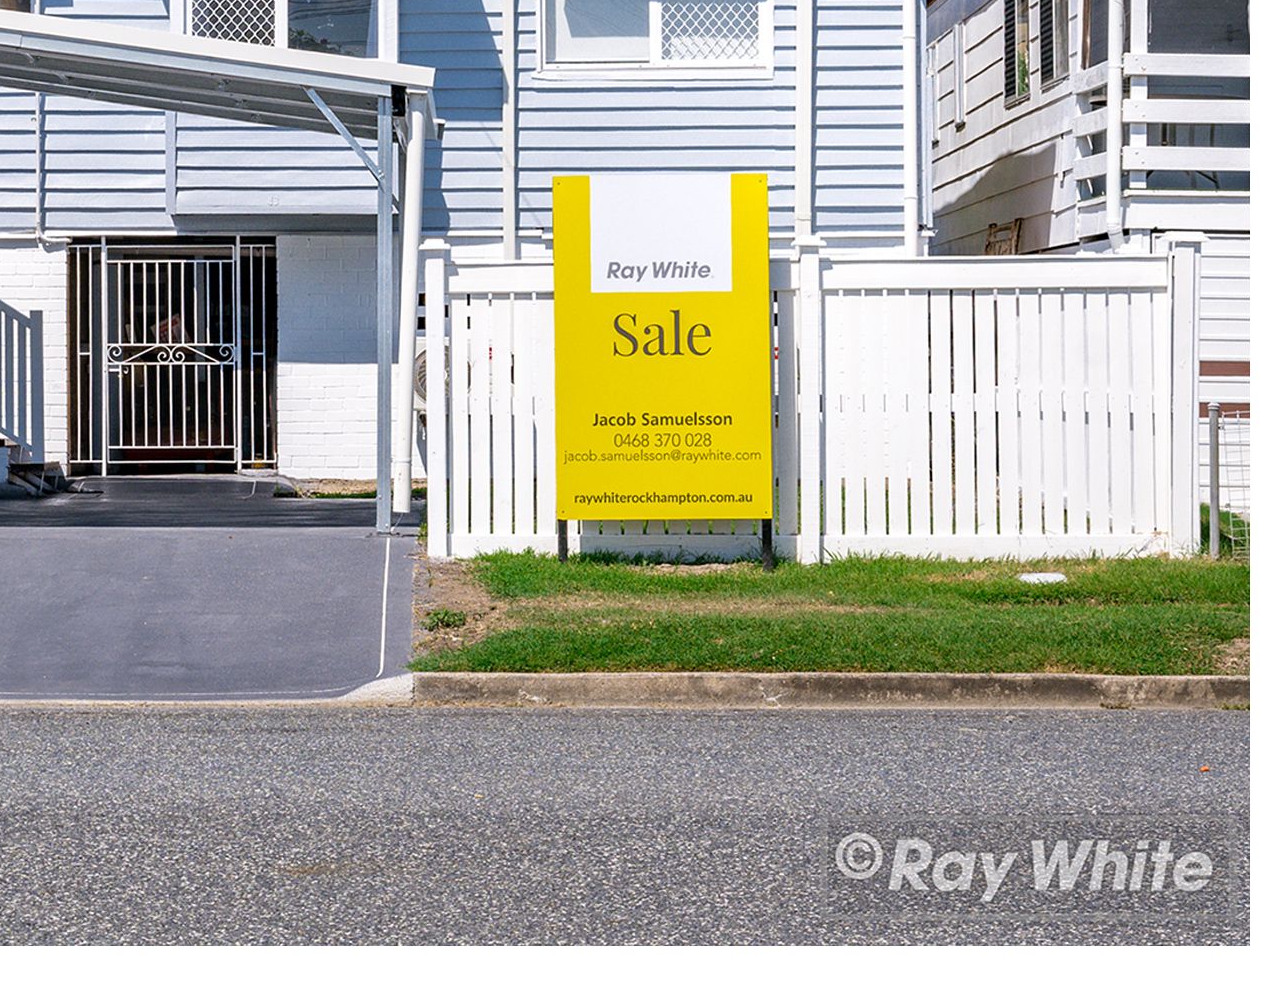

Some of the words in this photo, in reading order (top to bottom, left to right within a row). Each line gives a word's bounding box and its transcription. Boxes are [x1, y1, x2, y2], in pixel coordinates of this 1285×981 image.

[607, 261, 647, 282] Ray
[652, 261, 711, 279] White
[613, 309, 712, 357] Sale
[592, 412, 636, 427] Jacob
[641, 412, 733, 426] Samuelsson
[614, 433, 650, 448] 0468
[654, 433, 681, 448] 370
[684, 433, 712, 448] 028
[563, 449, 762, 465] jacob.samuelsson@raywhite.com
[574, 492, 753, 506] raywhiterockhampton.com.au
